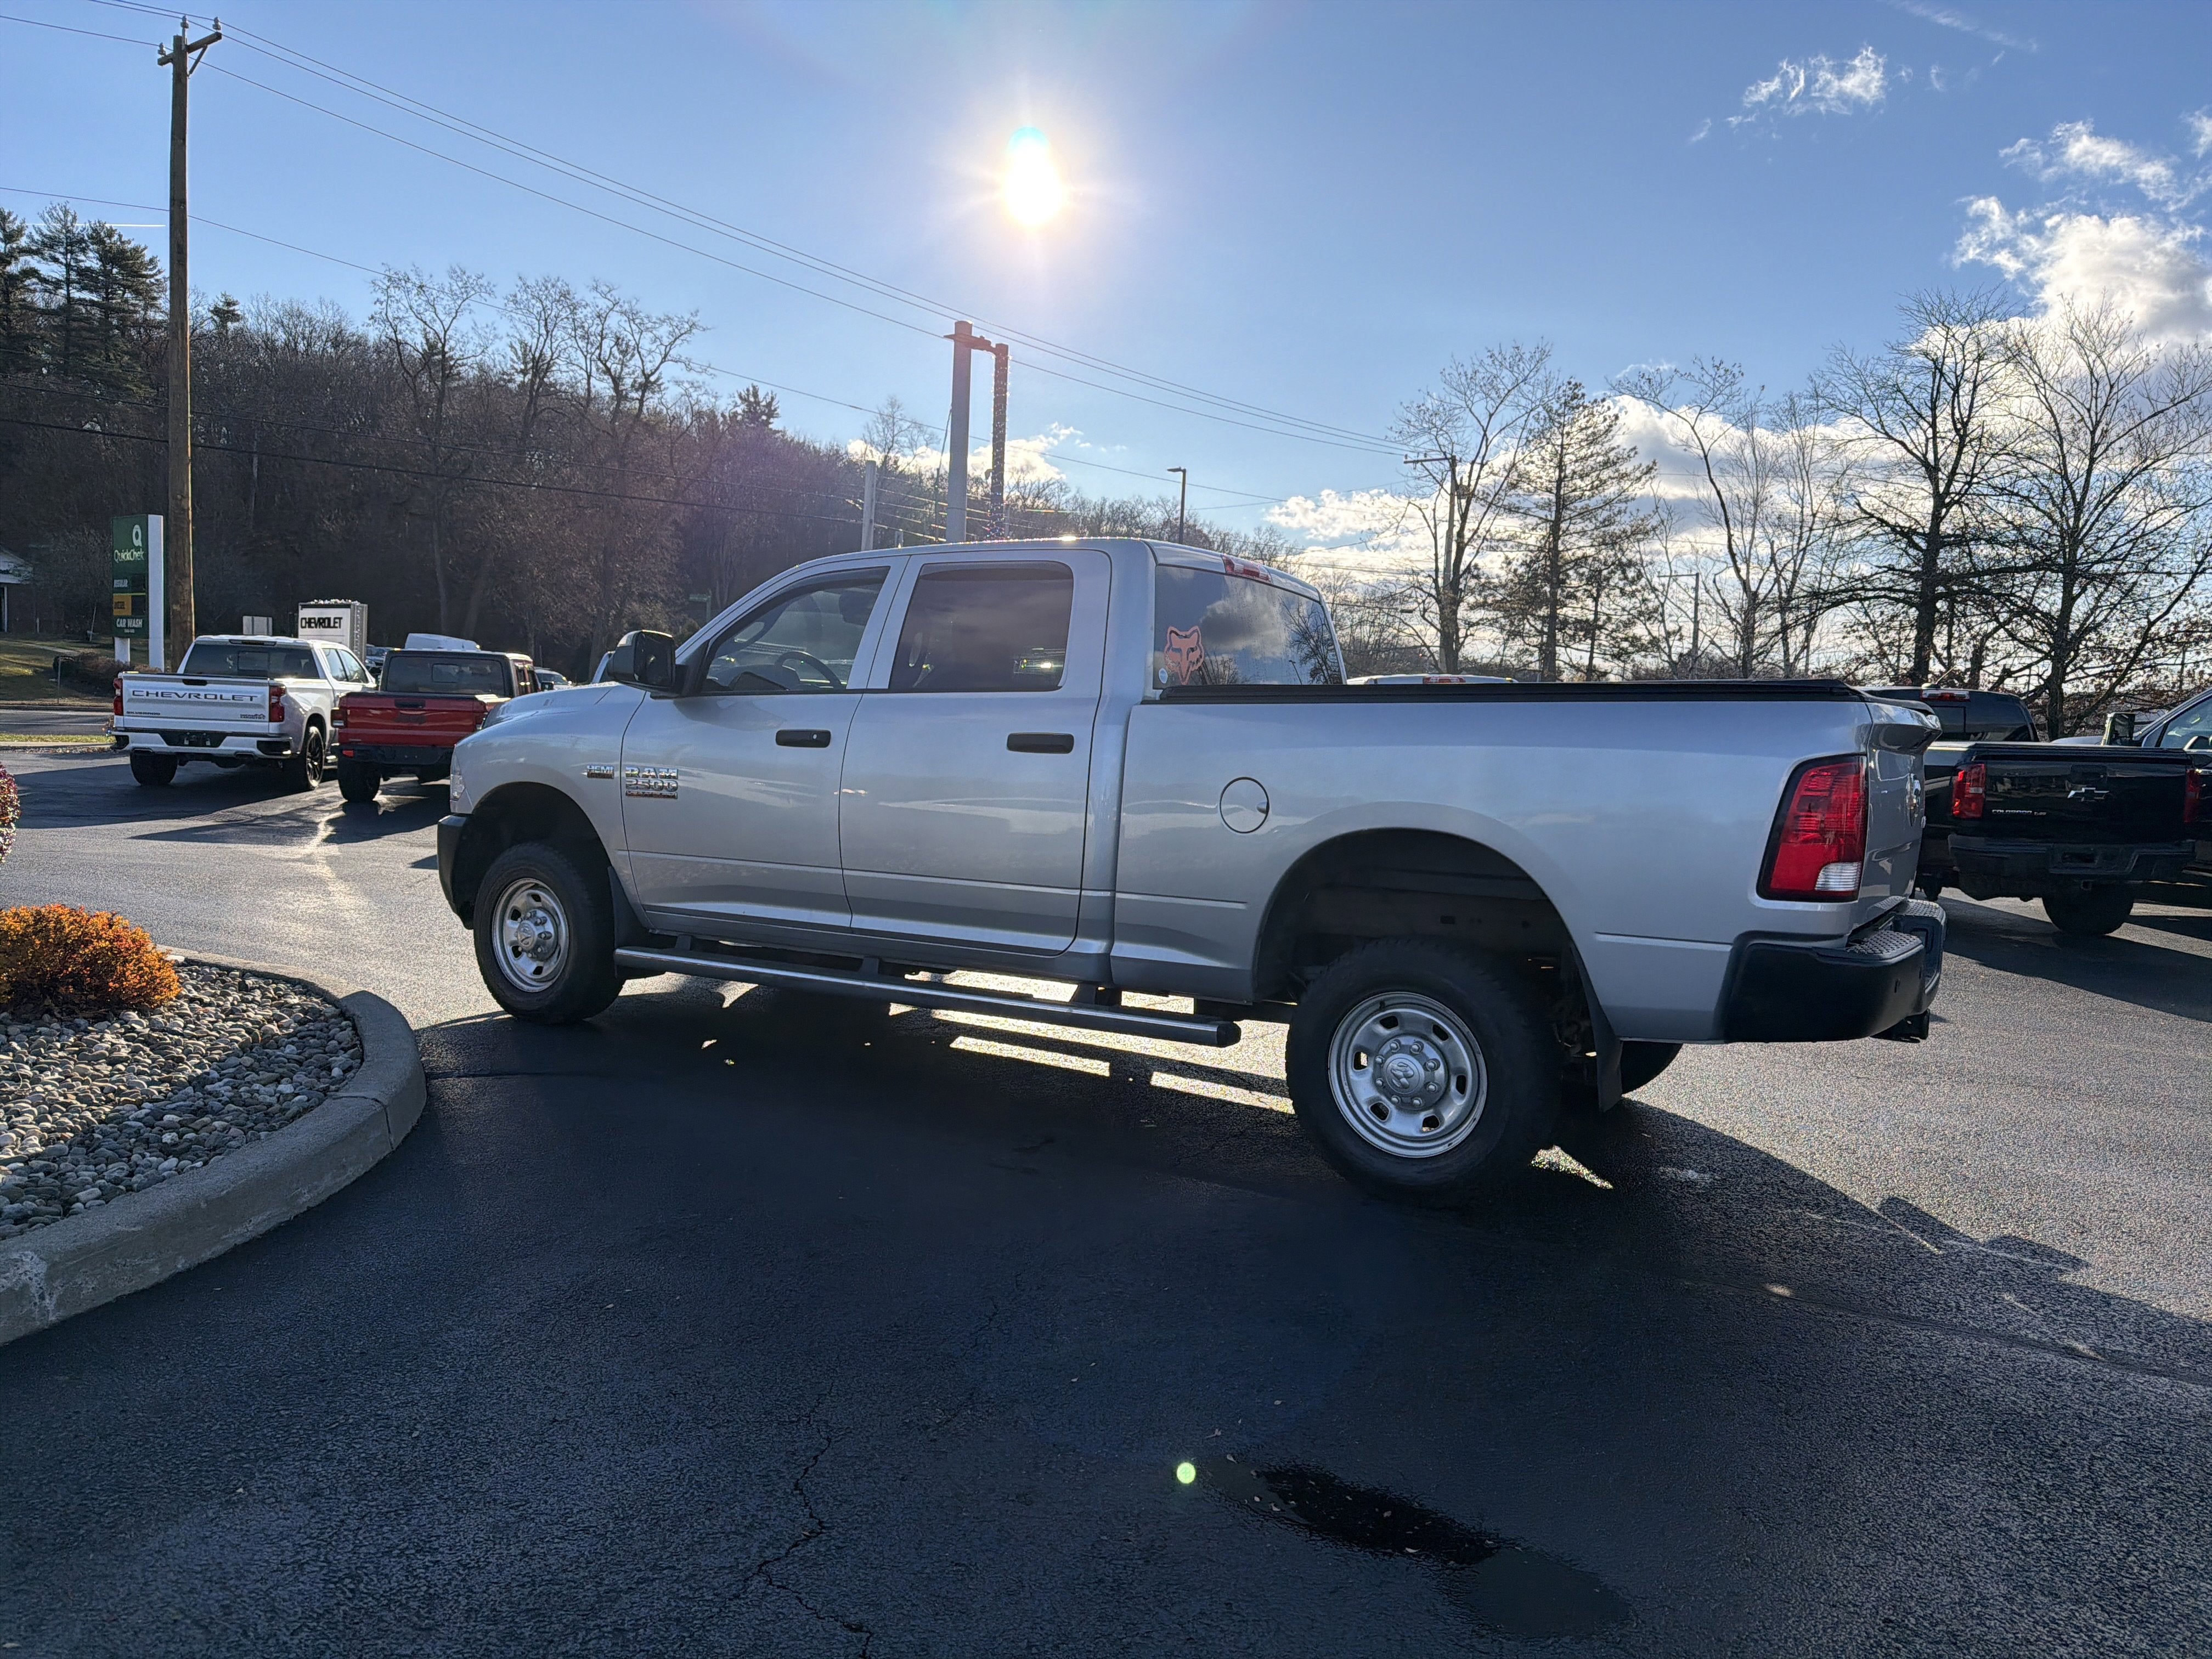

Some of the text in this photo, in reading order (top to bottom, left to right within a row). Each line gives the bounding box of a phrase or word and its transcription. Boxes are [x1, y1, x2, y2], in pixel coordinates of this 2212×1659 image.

[114, 548, 145, 563] QuickChek
[116, 618, 143, 628] CAR WASH
[300, 617, 343, 629] CHEVROLET
[132, 690, 258, 702] CHEVROLET
[625, 766, 679, 780] RAM
[625, 778, 679, 792] 2500
